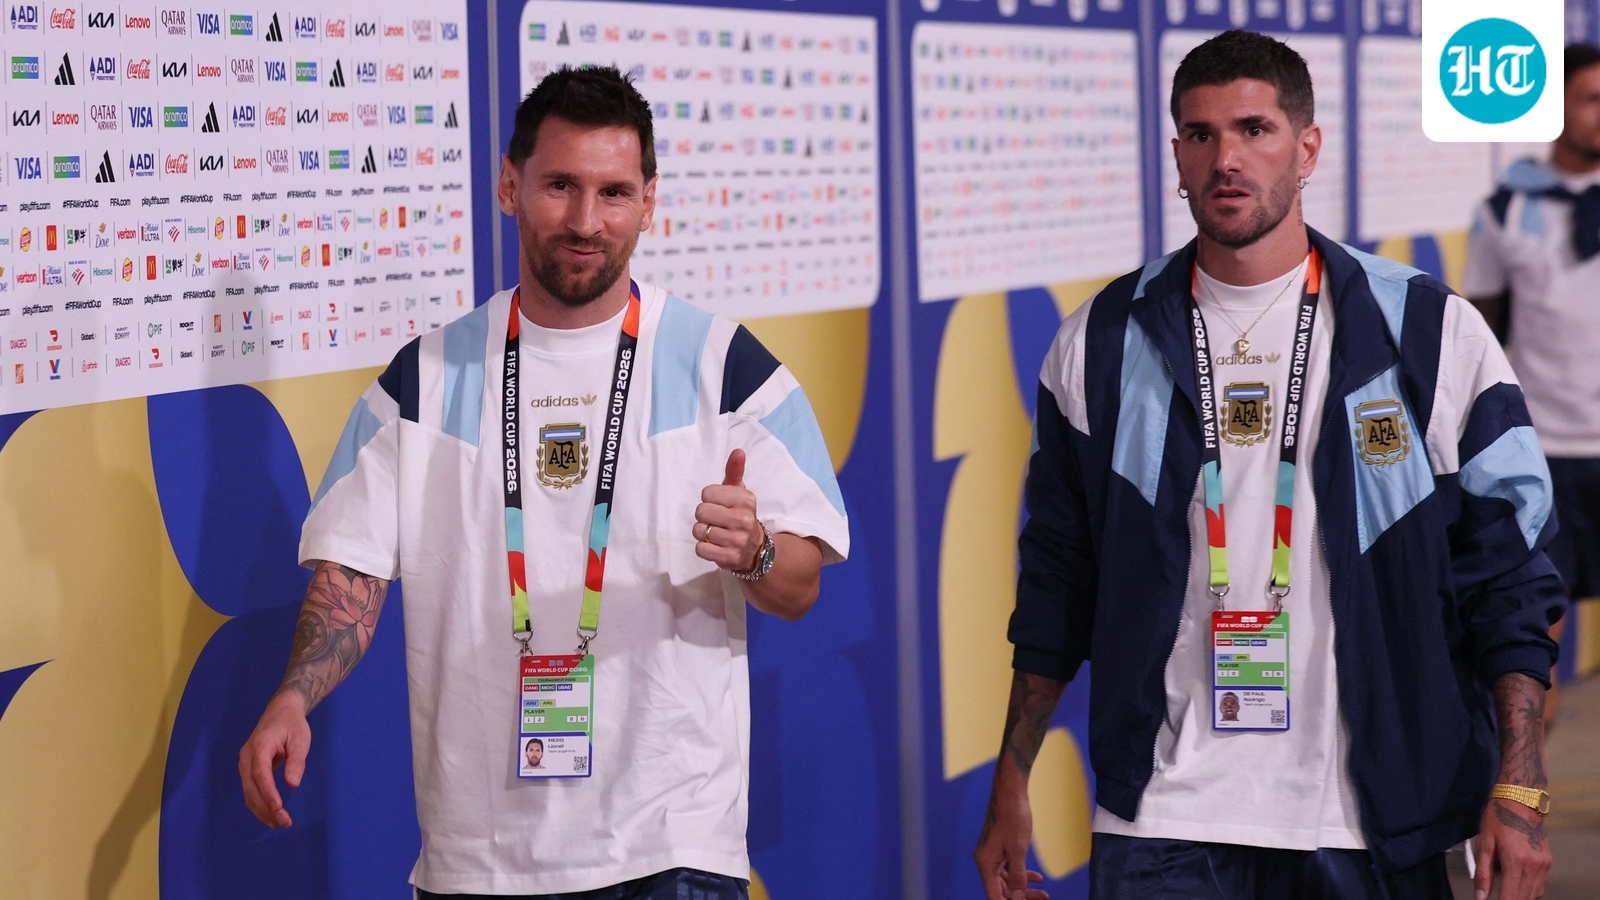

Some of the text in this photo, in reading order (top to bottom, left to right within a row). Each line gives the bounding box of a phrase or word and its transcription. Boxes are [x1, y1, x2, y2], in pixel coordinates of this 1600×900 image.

[18, 5, 38, 23] ADI
[88, 12, 114, 28] KIA
[161, 10, 186, 27] QATAR
[125, 14, 150, 29] Lenovo
[197, 13, 219, 34] VISA
[230, 19, 252, 30] aramco
[301, 17, 316, 32] ADI
[168, 27, 186, 35] AIRWAYS
[356, 23, 375, 36] KIA
[384, 24, 404, 37] Lenovo
[441, 23, 458, 40] VISA
[13, 62, 38, 73] aramco
[97, 57, 115, 74] ADI
[163, 62, 187, 77] KIA
[197, 64, 221, 77] Lenovo
[231, 59, 254, 75] QATAR
[264, 61, 286, 81] VISA
[362, 63, 376, 77] ADI
[237, 75, 254, 83] AIRWAYS
[414, 67, 432, 80] KIA
[13, 110, 40, 126] KIA
[52, 111, 79, 125] Lenovo
[91, 105, 116, 121] QATAR
[128, 107, 153, 127] VISA
[164, 111, 188, 122] aramco
[239, 106, 255, 121] ADI
[297, 109, 318, 123] KIA
[328, 110, 349, 122] Lenovo
[387, 106, 406, 124] VISA
[97, 121, 117, 130] AIRWAYS
[136, 153, 154, 170] ADI
[200, 156, 223, 170] KIA
[233, 156, 257, 169] Lenovo
[266, 150, 288, 166] QATAR
[299, 151, 320, 170] VISA
[14, 157, 41, 179] VISA
[55, 161, 79, 173] aramco
[272, 165, 288, 173] AIRWAYS
[110, 198, 131, 206] FIFA.com
[223, 193, 242, 201] FIFA.com
[279, 224, 290, 236] Dove
[297, 219, 313, 229] verizon
[117, 228, 136, 239] verizon
[95, 234, 109, 248] Dove
[212, 258, 229, 268] verizon
[93, 268, 112, 276] Hisense
[192, 264, 204, 277] Dove
[16, 273, 37, 283] verizon
[226, 288, 245, 296] FIFA.com
[113, 297, 133, 306] FIFA.com
[10, 339, 27, 349] DIAGEO
[115, 357, 131, 367] DIAGEO
[1215, 353, 1262, 365] adidas
[1192, 307, 1216, 448] FIFA WORLD CUP 2026
[1284, 305, 1313, 447] FIFA WORLD CUP 2026
[531, 395, 578, 408] adidas
[601, 349, 632, 490] FIFA WORLD CUP 2026
[1232, 400, 1259, 427] AFA
[506, 351, 518, 492] FIFA WORLD CUP 2026
[1369, 417, 1397, 446] AFA
[549, 441, 577, 469] AFA
